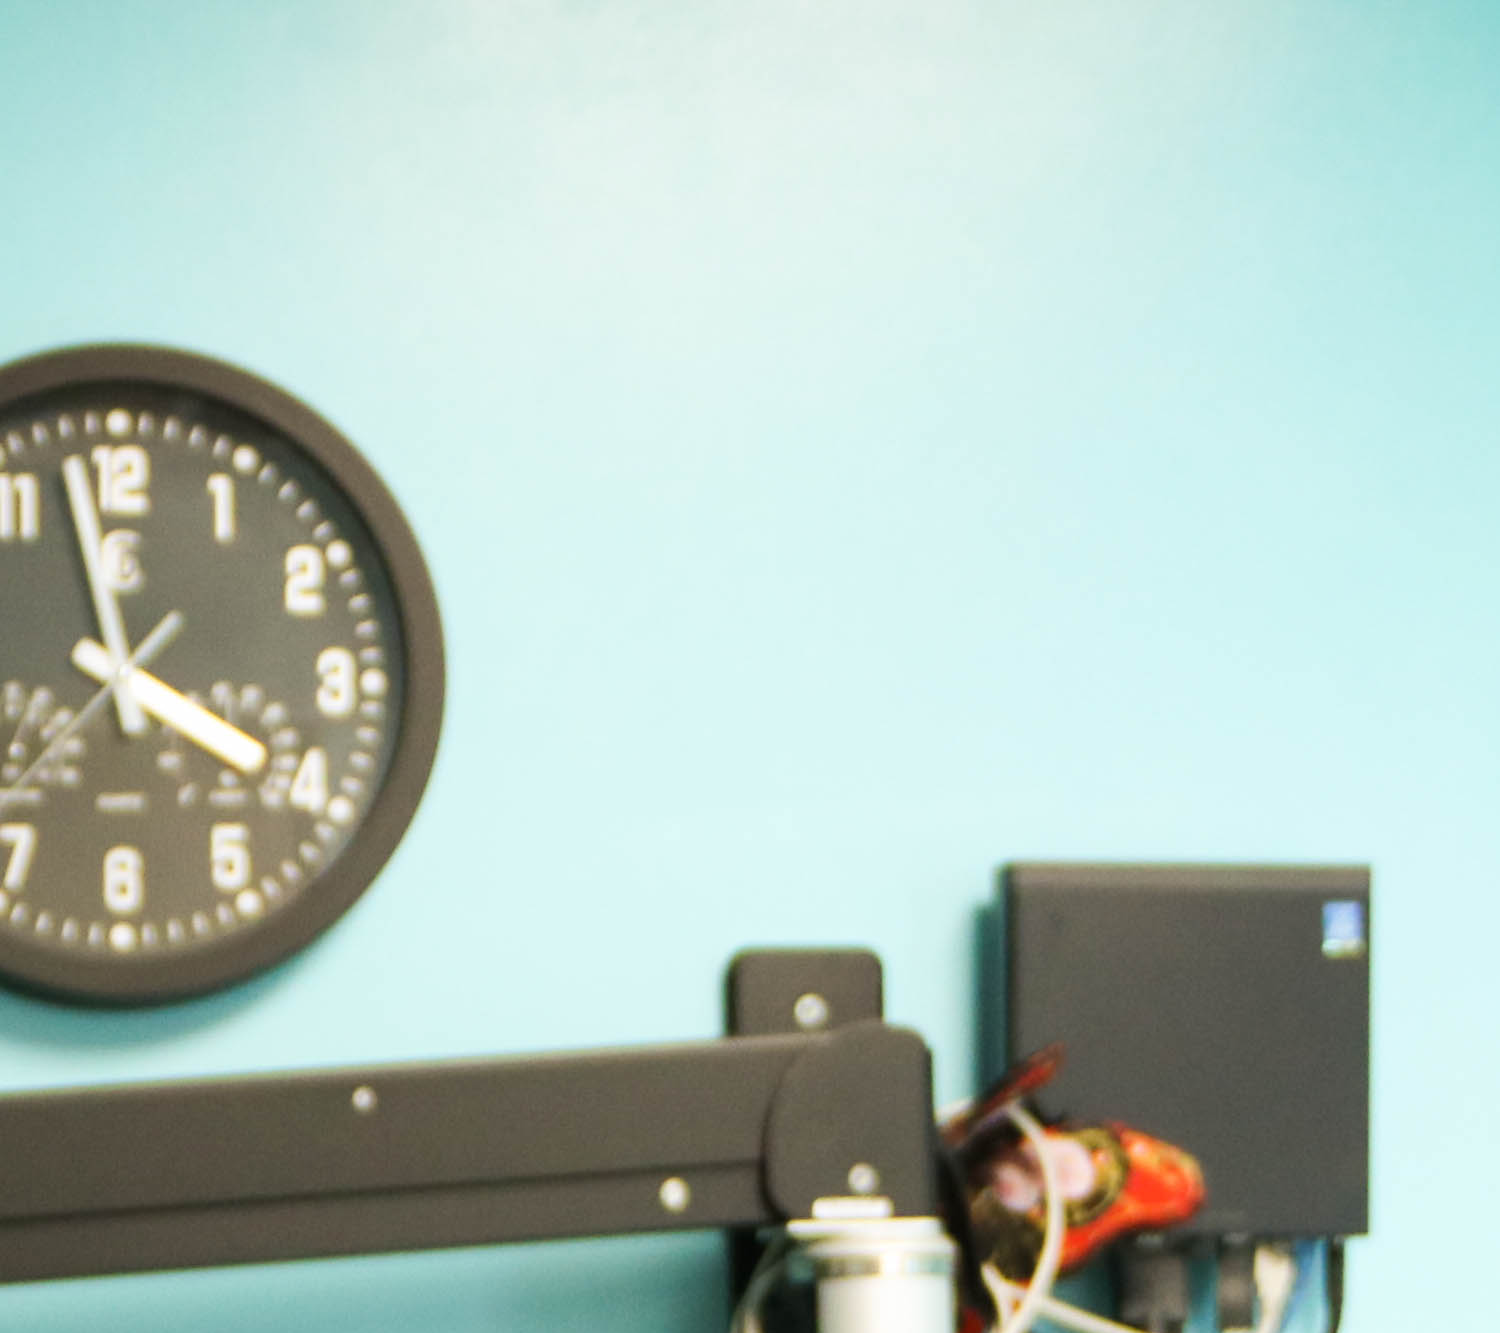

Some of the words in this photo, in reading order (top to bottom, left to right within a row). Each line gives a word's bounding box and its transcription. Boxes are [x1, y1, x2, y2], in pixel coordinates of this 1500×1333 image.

[91, 445, 150, 517] 12
[207, 471, 236, 544] 1
[284, 544, 326, 616] 2
[315, 646, 358, 718] 3
[289, 745, 328, 814] 4
[210, 822, 252, 892] 5
